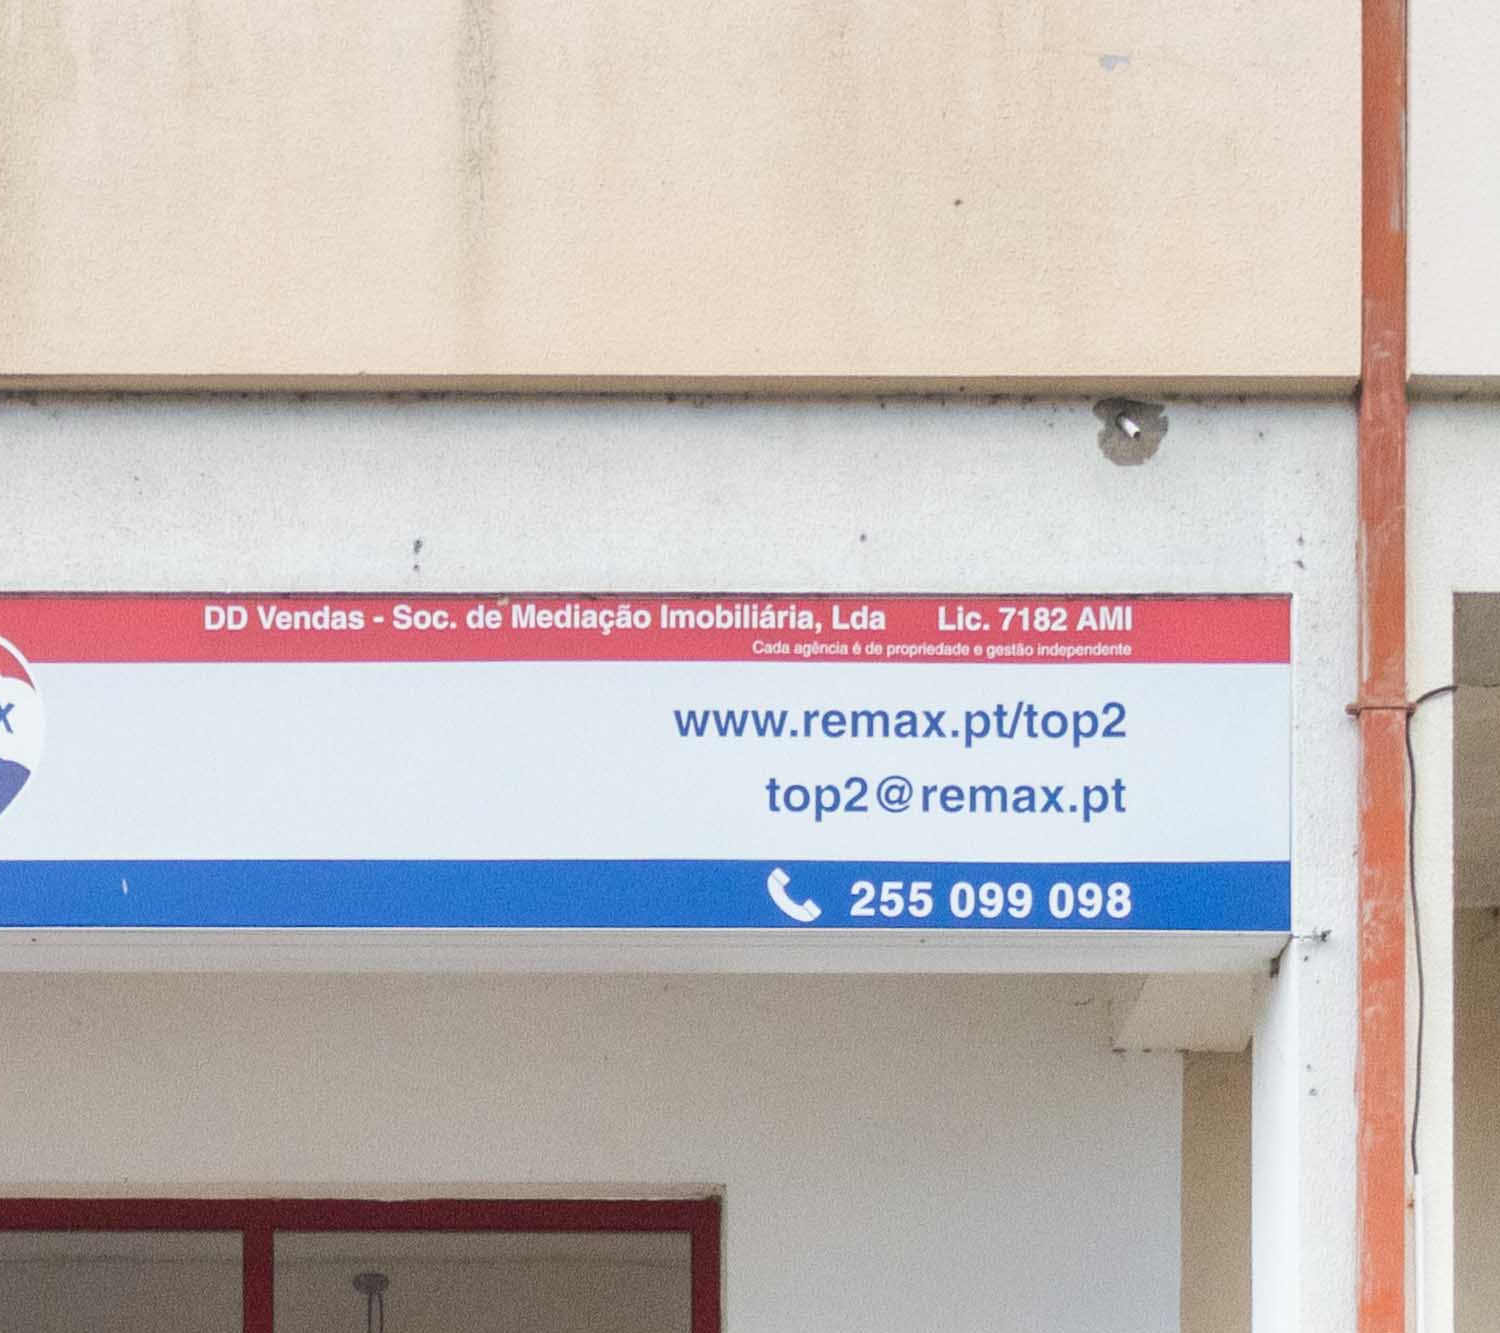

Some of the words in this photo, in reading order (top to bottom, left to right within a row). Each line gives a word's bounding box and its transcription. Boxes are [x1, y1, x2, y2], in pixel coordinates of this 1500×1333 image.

[204, 606, 248, 630] DD
[257, 605, 364, 630] Vendas
[392, 605, 457, 630] Soc.
[466, 604, 502, 630] de
[511, 604, 651, 635] Mediação
[661, 604, 822, 634] Imobiliária,
[832, 605, 886, 631] Lda
[938, 606, 990, 632] Lic.
[1000, 607, 1067, 632] 7182
[1076, 607, 1132, 632] AMI
[752, 640, 790, 656] Cada
[794, 640, 848, 660] agência
[852, 641, 861, 656] é
[865, 641, 883, 657] de
[887, 641, 970, 661] propriedade
[974, 645, 983, 657] e
[986, 642, 1034, 661] gestão
[1037, 643, 1132, 661] independente
[673, 701, 1127, 748] www.remax.pt/top2
[765, 775, 1127, 822] top2@remax.pt
[850, 881, 933, 918] 255
[949, 882, 1033, 919] 099
[1048, 882, 1132, 919] 098
